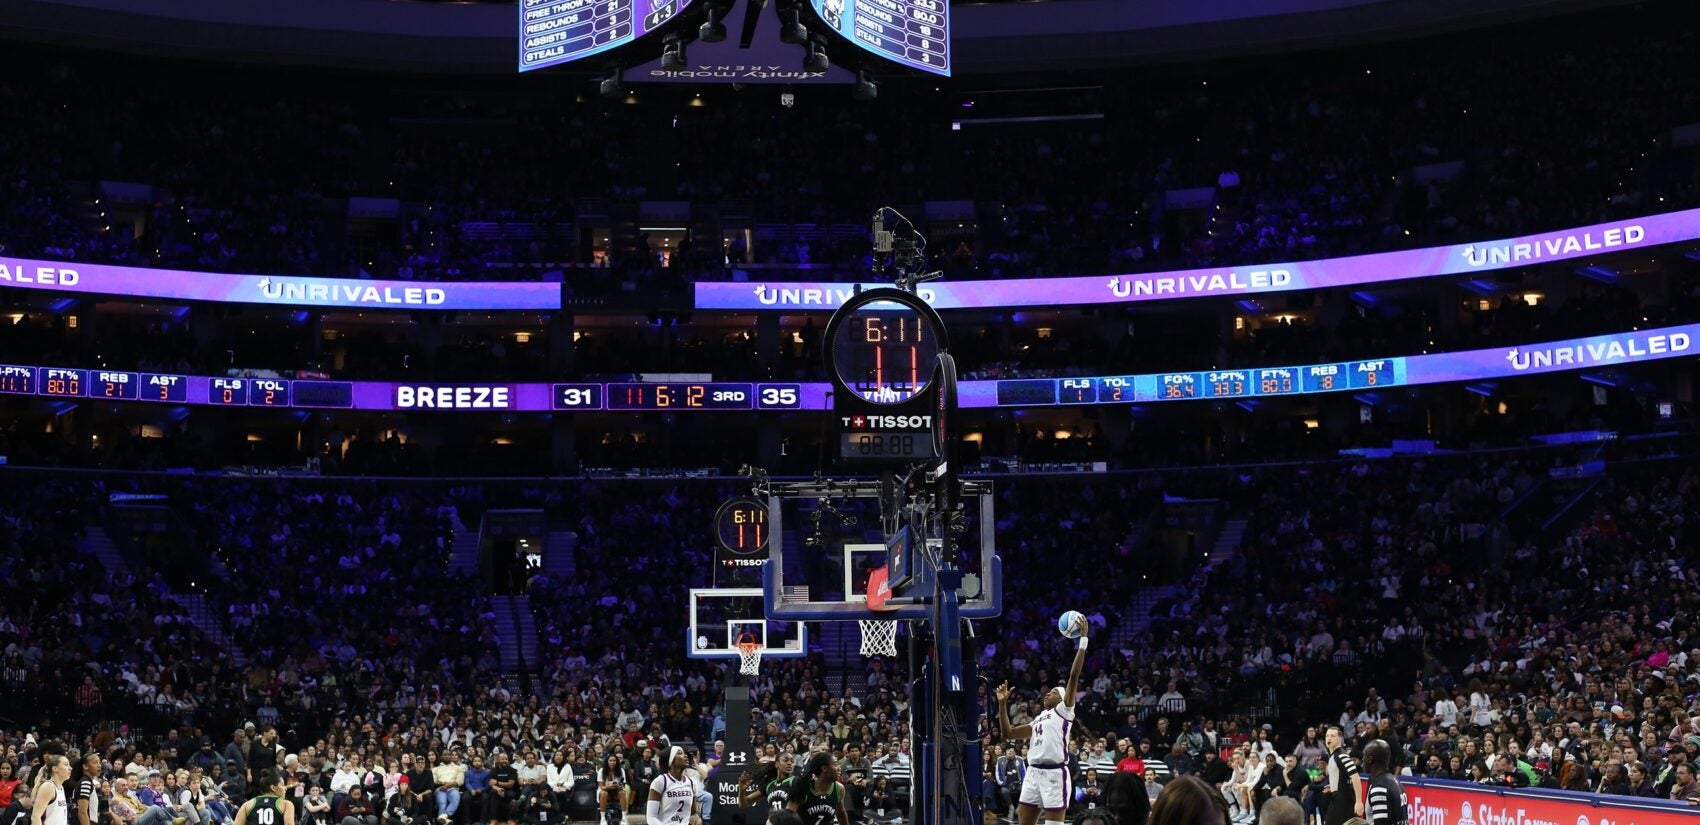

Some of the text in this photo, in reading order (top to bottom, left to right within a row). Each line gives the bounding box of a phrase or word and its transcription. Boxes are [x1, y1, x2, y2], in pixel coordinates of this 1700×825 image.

[526, 8, 551, 20] FREE
[552, 1, 584, 15] THROW
[608, 1, 619, 12] 21
[855, 1, 893, 23] REBOUNDS
[609, 16, 617, 25] 3
[913, 9, 937, 24] 80.0
[526, 14, 579, 34] REBOUNDS
[856, 14, 883, 34] ASSISTS
[920, 25, 931, 36] 18
[526, 32, 567, 48] ASSISTS
[609, 30, 617, 39] 2
[856, 27, 882, 46] STEALS
[922, 40, 930, 49] 8
[525, 46, 564, 62] STEALS
[922, 53, 930, 63] 3
[650, 70, 827, 79] xfinity mobile
[1466, 225, 1645, 267] UNRIVALED
[1111, 269, 1291, 298] UNRIVALED
[261, 279, 446, 305] UNRIVALED
[866, 317, 922, 342] 6:11
[1511, 332, 1690, 370] UNRIVALED
[0, 367, 30, 377] -PT%
[876, 346, 918, 391] 11
[1311, 366, 1338, 376] REB
[1358, 361, 1385, 372] AST
[48, 370, 79, 380] FT%
[100, 372, 129, 383] REB
[150, 376, 179, 386] AST
[1164, 375, 1194, 384] FG%
[1209, 372, 1245, 382] 3-PT%
[1261, 370, 1291, 379] FT%
[1368, 372, 1377, 385] 8
[48, 380, 79, 394] 80.0
[215, 379, 242, 389] FLS
[255, 381, 284, 391] TOL
[1064, 380, 1090, 389] FLS
[1104, 378, 1130, 387] TOL
[1213, 382, 1243, 396] 33.3
[105, 383, 123, 397] 21
[160, 386, 168, 399] 3
[224, 389, 232, 403] 0
[564, 388, 592, 405] 31
[627, 386, 745, 407] 11 6:12 3RD
[762, 388, 797, 405] 35
[1078, 389, 1082, 401] 1
[1113, 388, 1121, 400] 2
[1166, 385, 1194, 398] 36.4
[266, 391, 274, 404] 2
[397, 386, 509, 408] BREEZE
[867, 415, 932, 429] TISSOT
[734, 510, 763, 523] 6:11
[739, 524, 760, 548] 11
[677, 800, 685, 812] 2
[257, 807, 275, 825] 10
